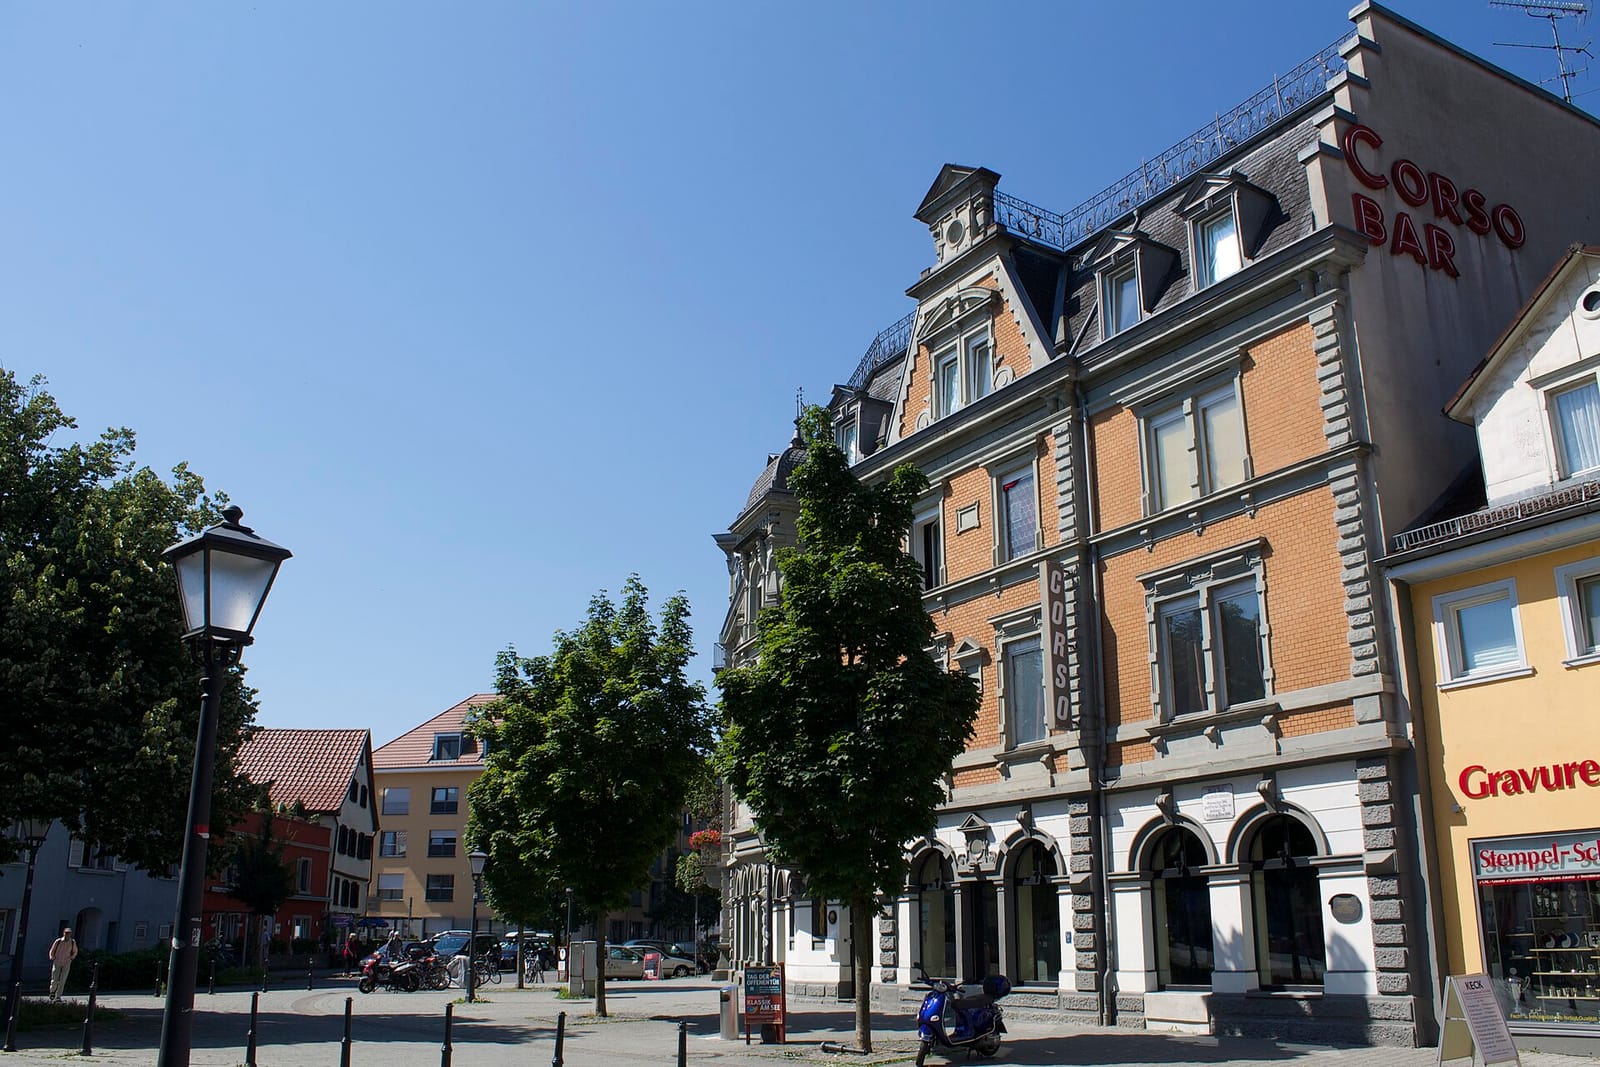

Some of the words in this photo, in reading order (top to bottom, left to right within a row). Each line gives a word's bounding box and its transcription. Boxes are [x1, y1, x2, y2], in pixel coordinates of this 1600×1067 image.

[1343, 124, 1526, 249] CORSO
[1352, 192, 1460, 278] BAR
[1050, 570, 1070, 721] CORSO
[1465, 981, 1484, 990] KECK
